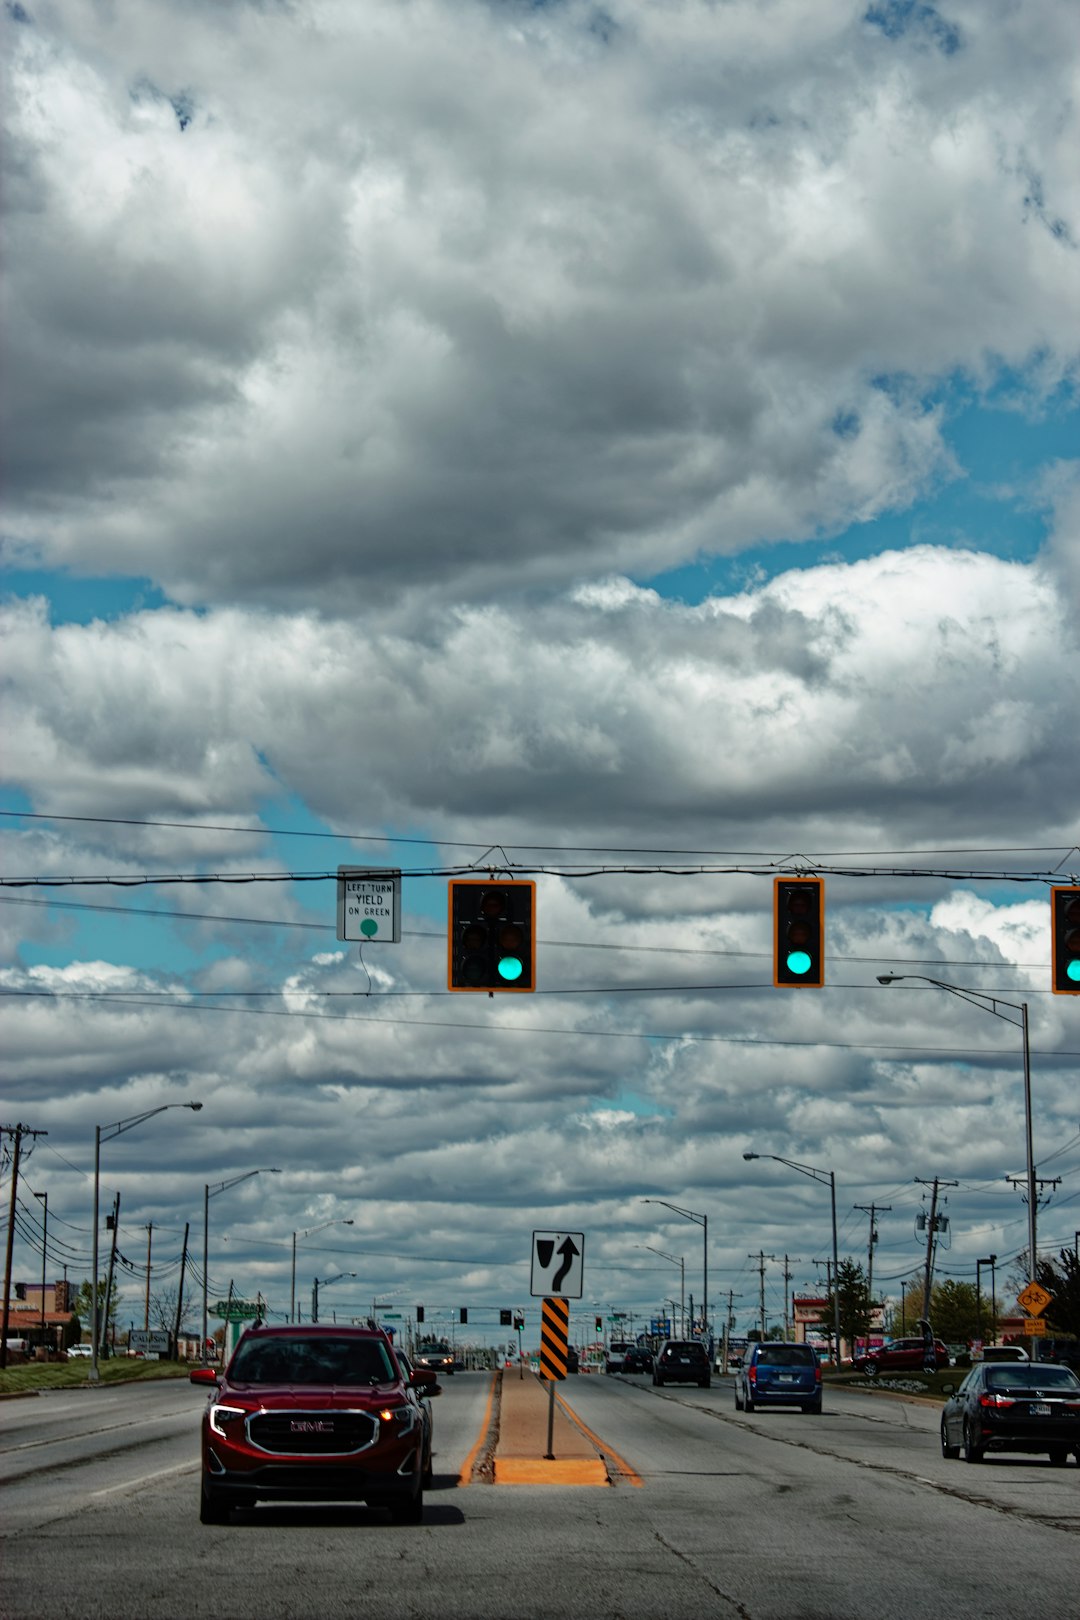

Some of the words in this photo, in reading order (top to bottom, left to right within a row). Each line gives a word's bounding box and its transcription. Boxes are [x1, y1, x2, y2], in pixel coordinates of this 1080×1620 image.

[347, 883, 365, 892] LEFT
[372, 884, 392, 893] TURN
[356, 894, 383, 905] YIELD
[348, 907, 360, 915] ON
[364, 908, 390, 916] GREEN
[290, 1420, 335, 1432] GMC
